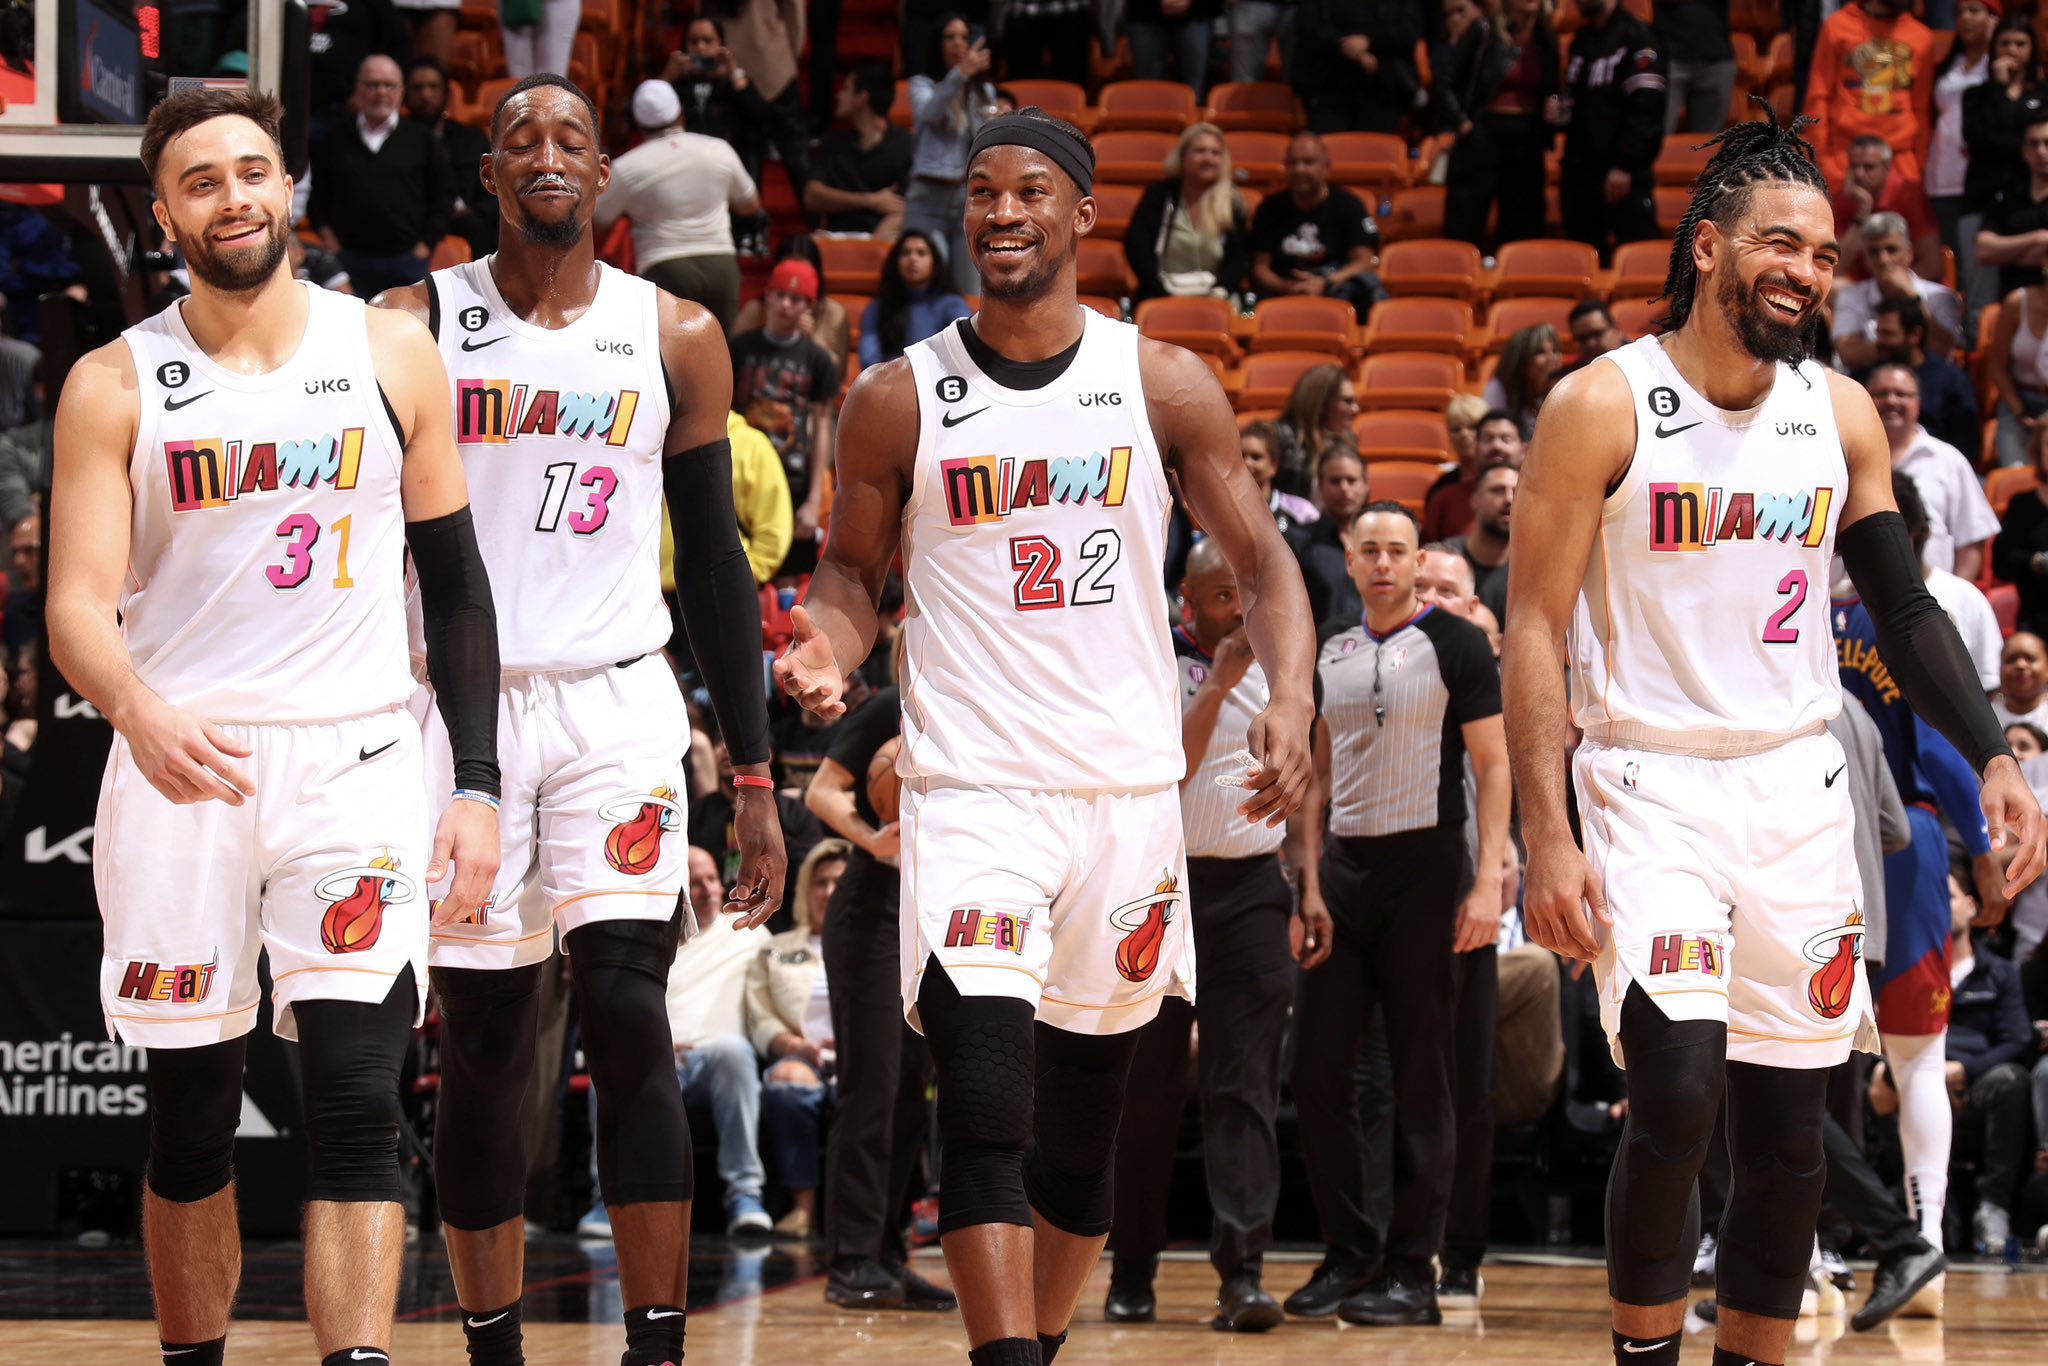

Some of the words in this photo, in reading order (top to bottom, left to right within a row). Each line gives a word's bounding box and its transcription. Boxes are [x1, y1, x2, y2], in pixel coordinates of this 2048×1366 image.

[535, 461, 621, 538] 13
[263, 512, 355, 593] 31
[1008, 528, 1122, 612] 22
[1761, 569, 1809, 646] 2
